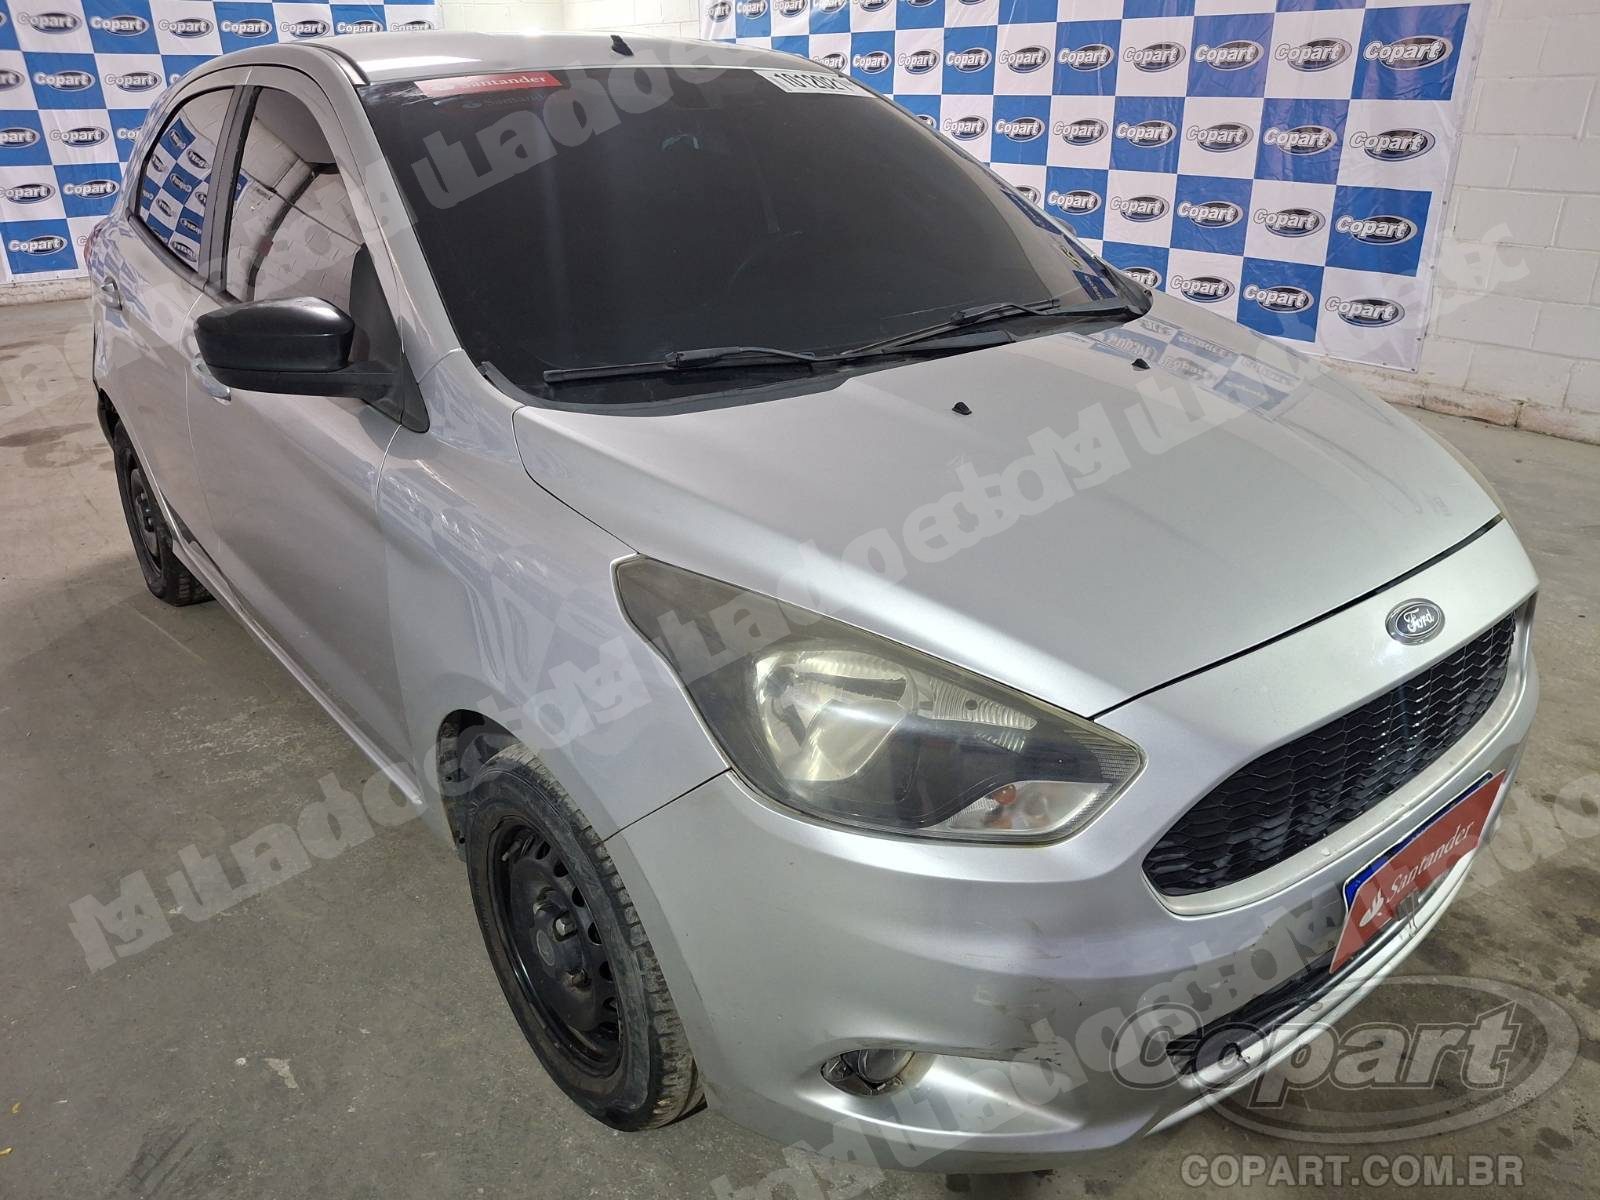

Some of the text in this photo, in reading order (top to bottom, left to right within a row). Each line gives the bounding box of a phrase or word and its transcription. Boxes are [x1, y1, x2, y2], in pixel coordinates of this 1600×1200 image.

[736, 1, 764, 15] Copart
[17, 12, 74, 30] Copart
[90, 16, 143, 31] Copart
[158, 19, 208, 34] Copart
[220, 20, 268, 34] Copart
[280, 22, 326, 36] Copart
[336, 22, 377, 35] Copart
[946, 51, 986, 67] Copart
[999, 49, 1044, 66] Copart
[1058, 48, 1106, 65] Copart
[1123, 46, 1178, 63] Copart
[1195, 45, 1255, 63] Copart
[1275, 42, 1343, 62] Copart
[1364, 40, 1441, 62] Copart
[852, 54, 887, 69] Copart
[898, 53, 936, 68] Copart
[34, 72, 89, 89] Copart
[104, 74, 154, 88] Copart
[943, 118, 984, 134] Copart
[995, 119, 1039, 135] Copart
[1053, 121, 1101, 138] Copart
[1116, 123, 1170, 141] Copart
[1186, 124, 1244, 144] Copart
[50, 129, 103, 144] Copart
[1264, 127, 1329, 148] Copart
[1349, 131, 1426, 153] Copart
[63, 183, 114, 197] Copart
[1048, 191, 1095, 210] Copart
[1110, 196, 1163, 216] Copart
[1177, 202, 1235, 221] Copart
[1254, 208, 1316, 230] Copart
[1335, 215, 1409, 239] Copart
[8, 238, 61, 254] Copart
[1170, 274, 1228, 296] Copart
[1243, 284, 1307, 308] Copart
[1325, 296, 1399, 321] Copart
[1403, 608, 1434, 632] Ford
[1386, 821, 1475, 904] Santander
